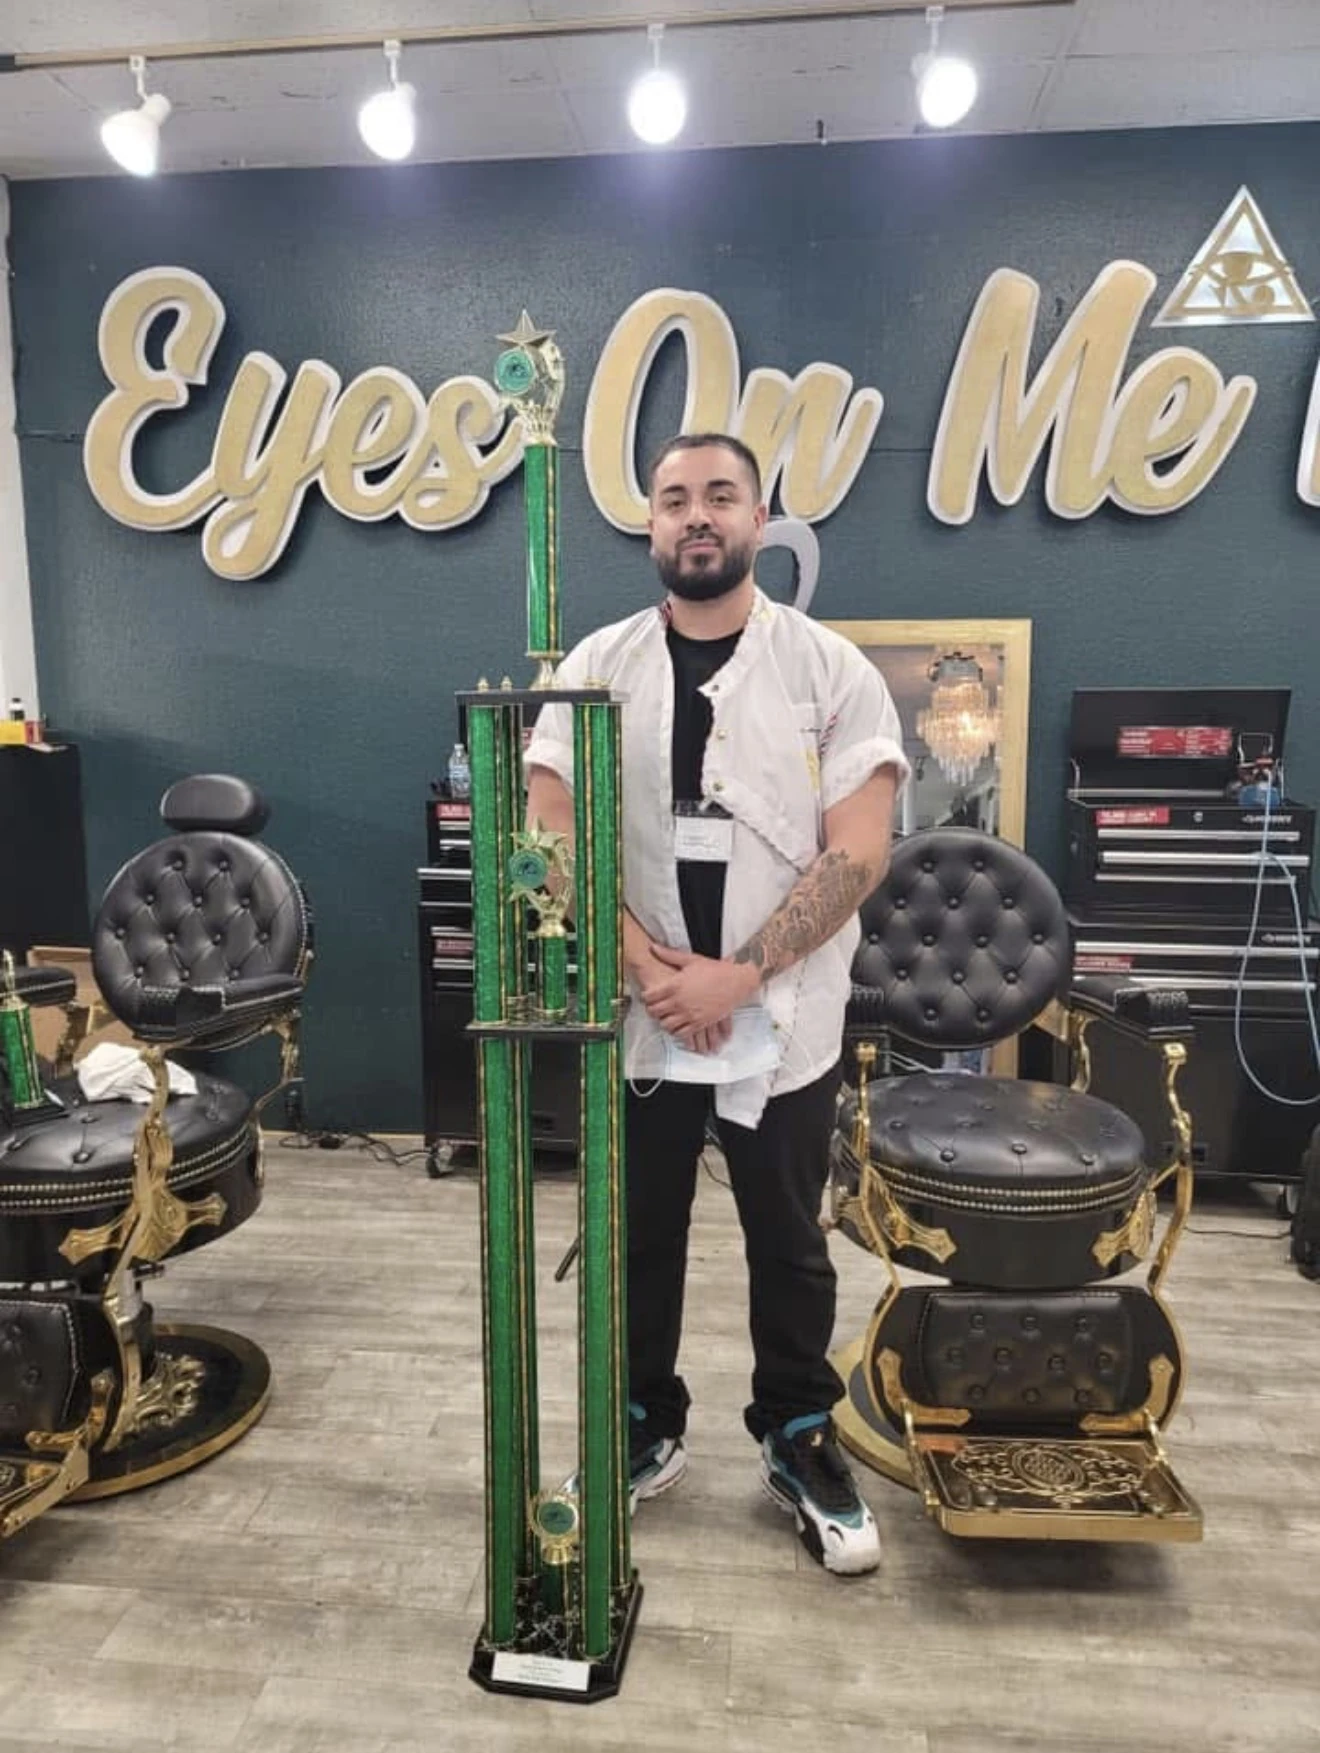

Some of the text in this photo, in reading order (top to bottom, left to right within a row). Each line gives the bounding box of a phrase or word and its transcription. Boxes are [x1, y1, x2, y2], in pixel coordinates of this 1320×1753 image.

[84, 266, 523, 580] Eyes
[584, 288, 884, 534] On
[927, 260, 1257, 525] Me
